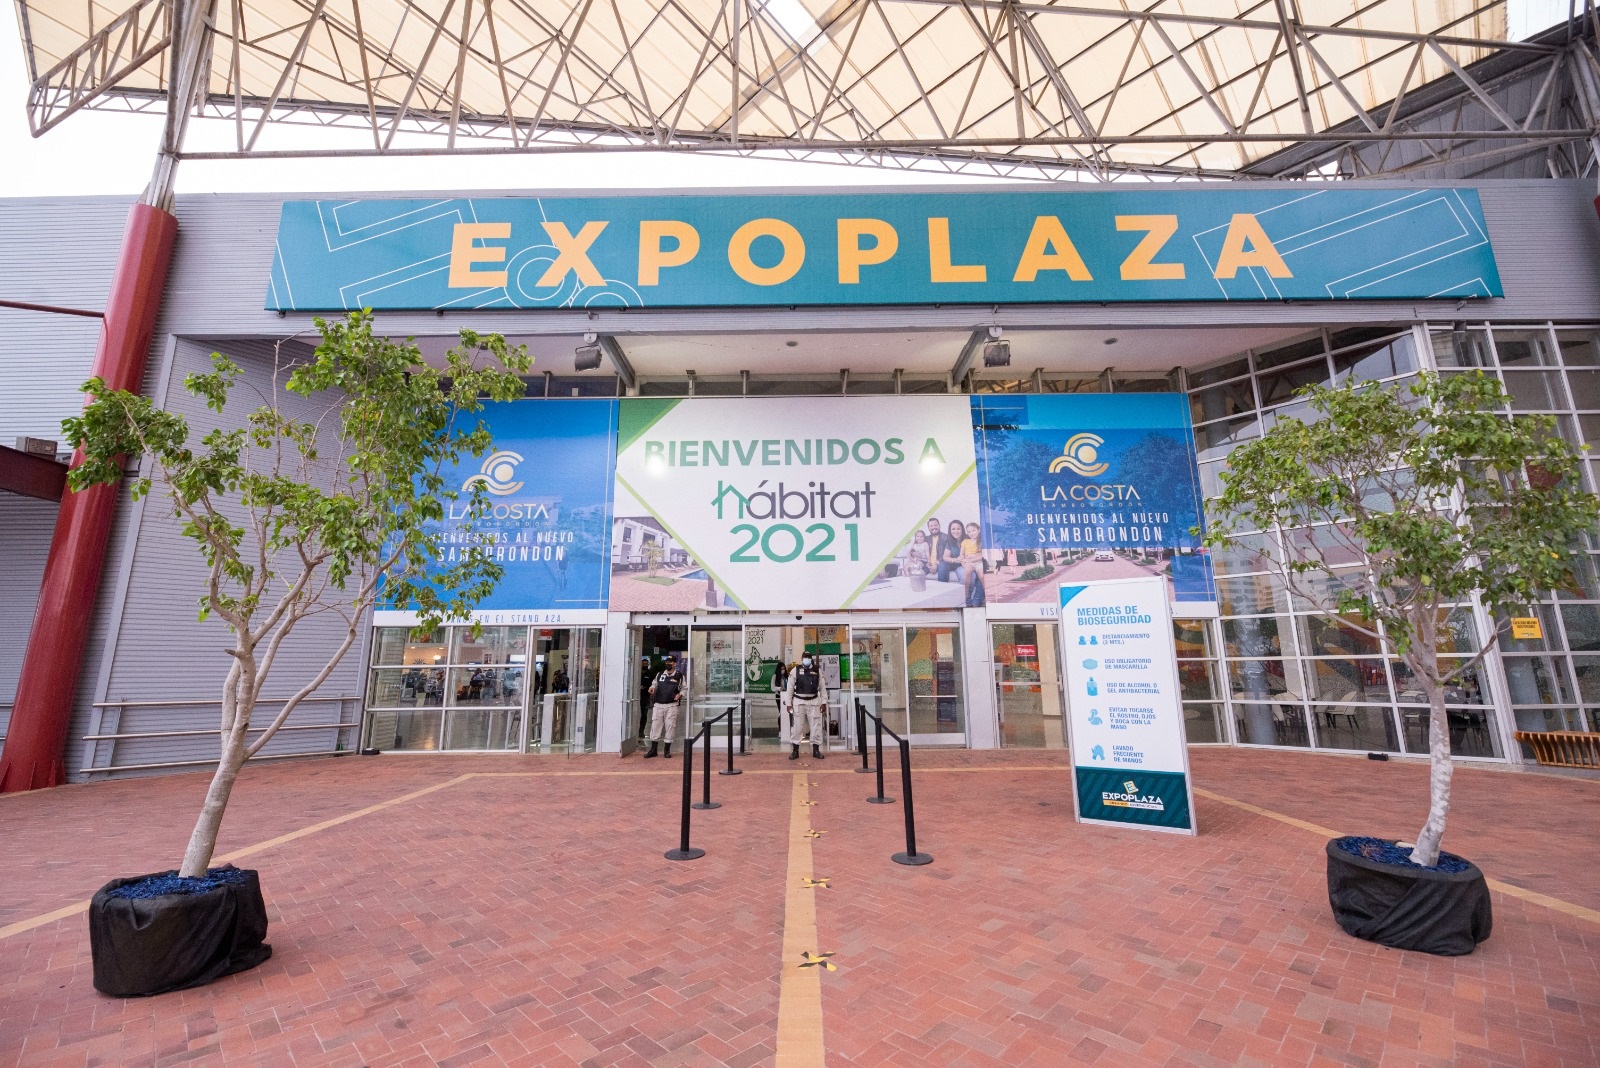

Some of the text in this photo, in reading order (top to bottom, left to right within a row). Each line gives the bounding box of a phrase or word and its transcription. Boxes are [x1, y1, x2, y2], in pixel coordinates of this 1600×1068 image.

[447, 212, 1294, 288] EXPOPLAZA
[644, 437, 946, 467] BIENVENIDOS A
[711, 480, 876, 520] hábitat
[1040, 485, 1141, 501] LA COSTA
[449, 504, 472, 520] LA
[1027, 512, 1169, 525] BIENVENIDOS AL NUEVO
[516, 532, 528, 542] AL
[536, 532, 574, 542] NUEVO
[1038, 524, 1162, 543] SAMBORONDÓN
[730, 523, 859, 563] 2021
[480, 615, 490, 623] EN
[496, 615, 504, 623] EL
[511, 614, 539, 623] STAND
[545, 614, 565, 622] A2A.
[1077, 605, 1138, 616] MEDIDAS DE
[1078, 615, 1151, 626] BIOSEGURIDAD
[1102, 792, 1163, 804] EXPOPLAZA
